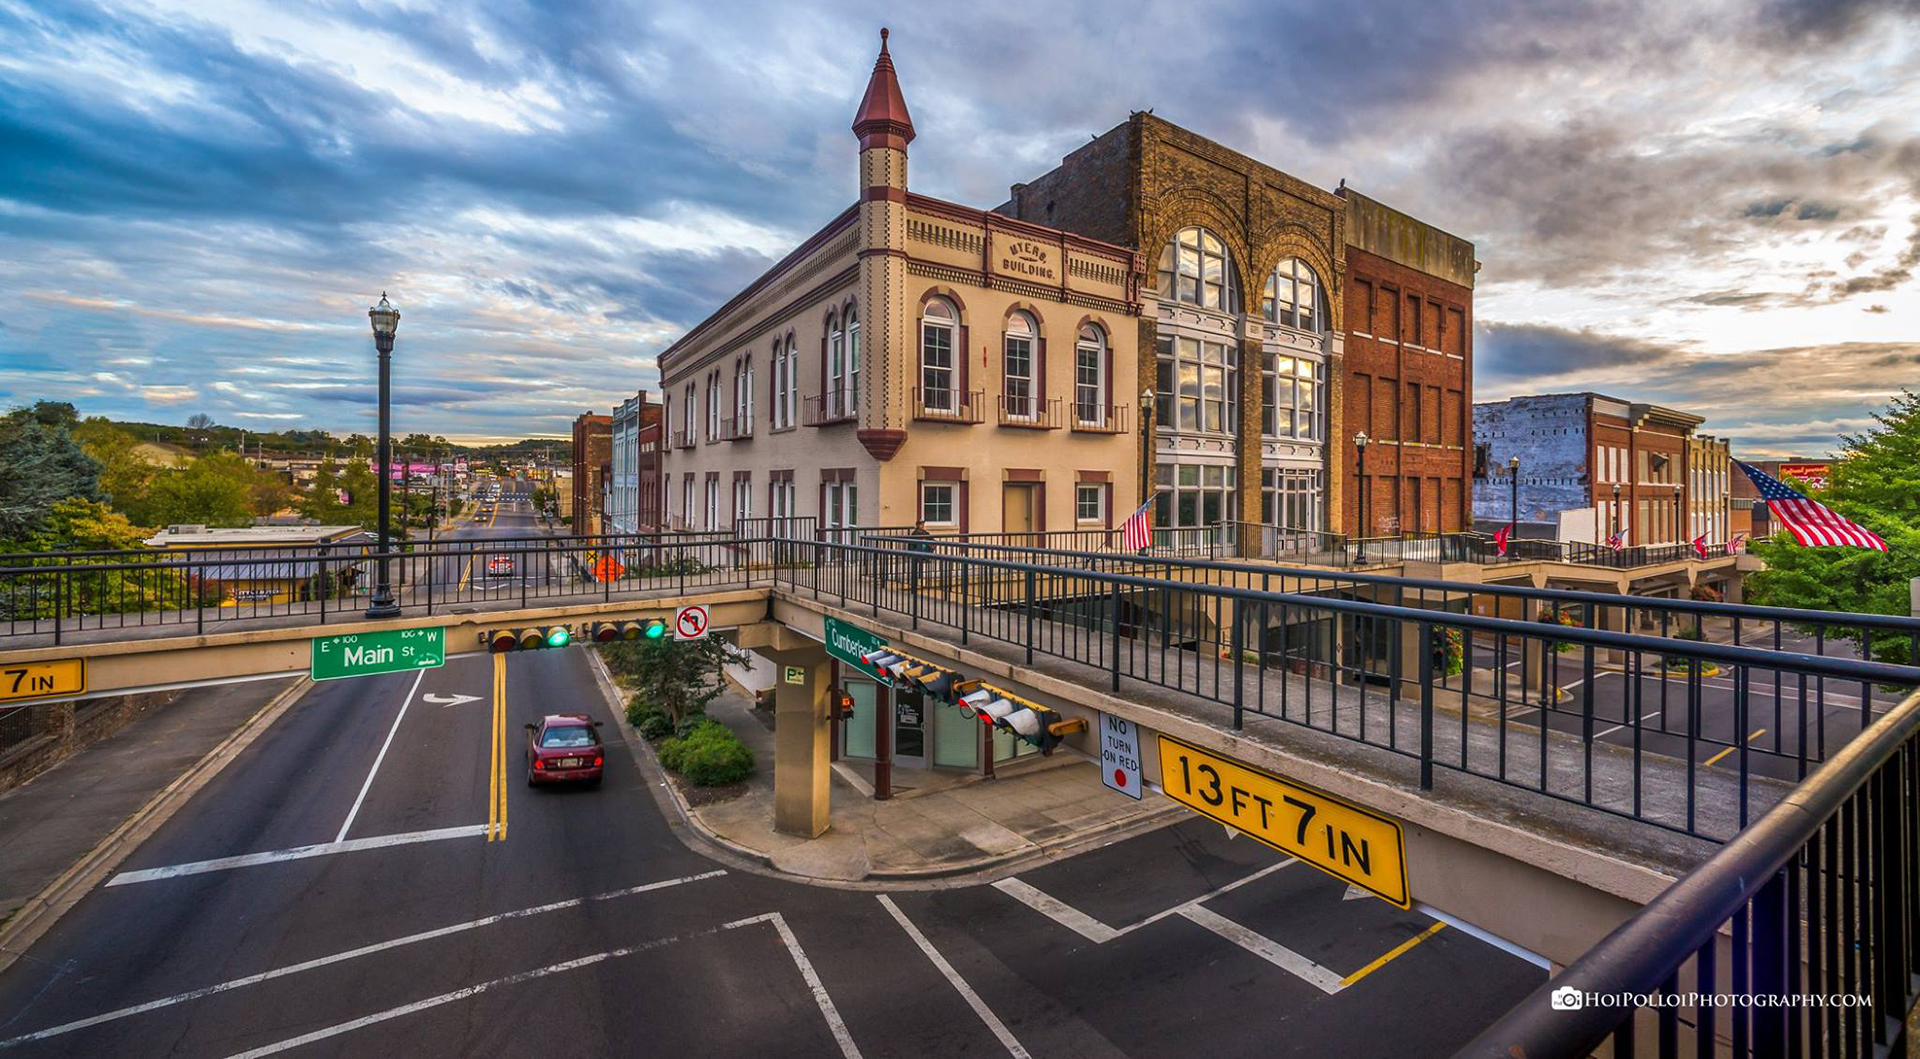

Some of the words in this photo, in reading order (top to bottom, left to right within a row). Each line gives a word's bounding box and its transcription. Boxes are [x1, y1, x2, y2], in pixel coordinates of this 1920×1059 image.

[321, 641, 330, 653] E
[342, 635, 358, 644] 100
[427, 632, 437, 642] W
[344, 644, 394, 667] Main
[401, 645, 415, 657] St
[4, 668, 28, 693] 7
[31, 675, 53, 692] IN
[1108, 716, 1127, 735] NO
[1107, 735, 1132, 755] TURN
[1103, 749, 1116, 764] ON
[1119, 755, 1137, 772] RED
